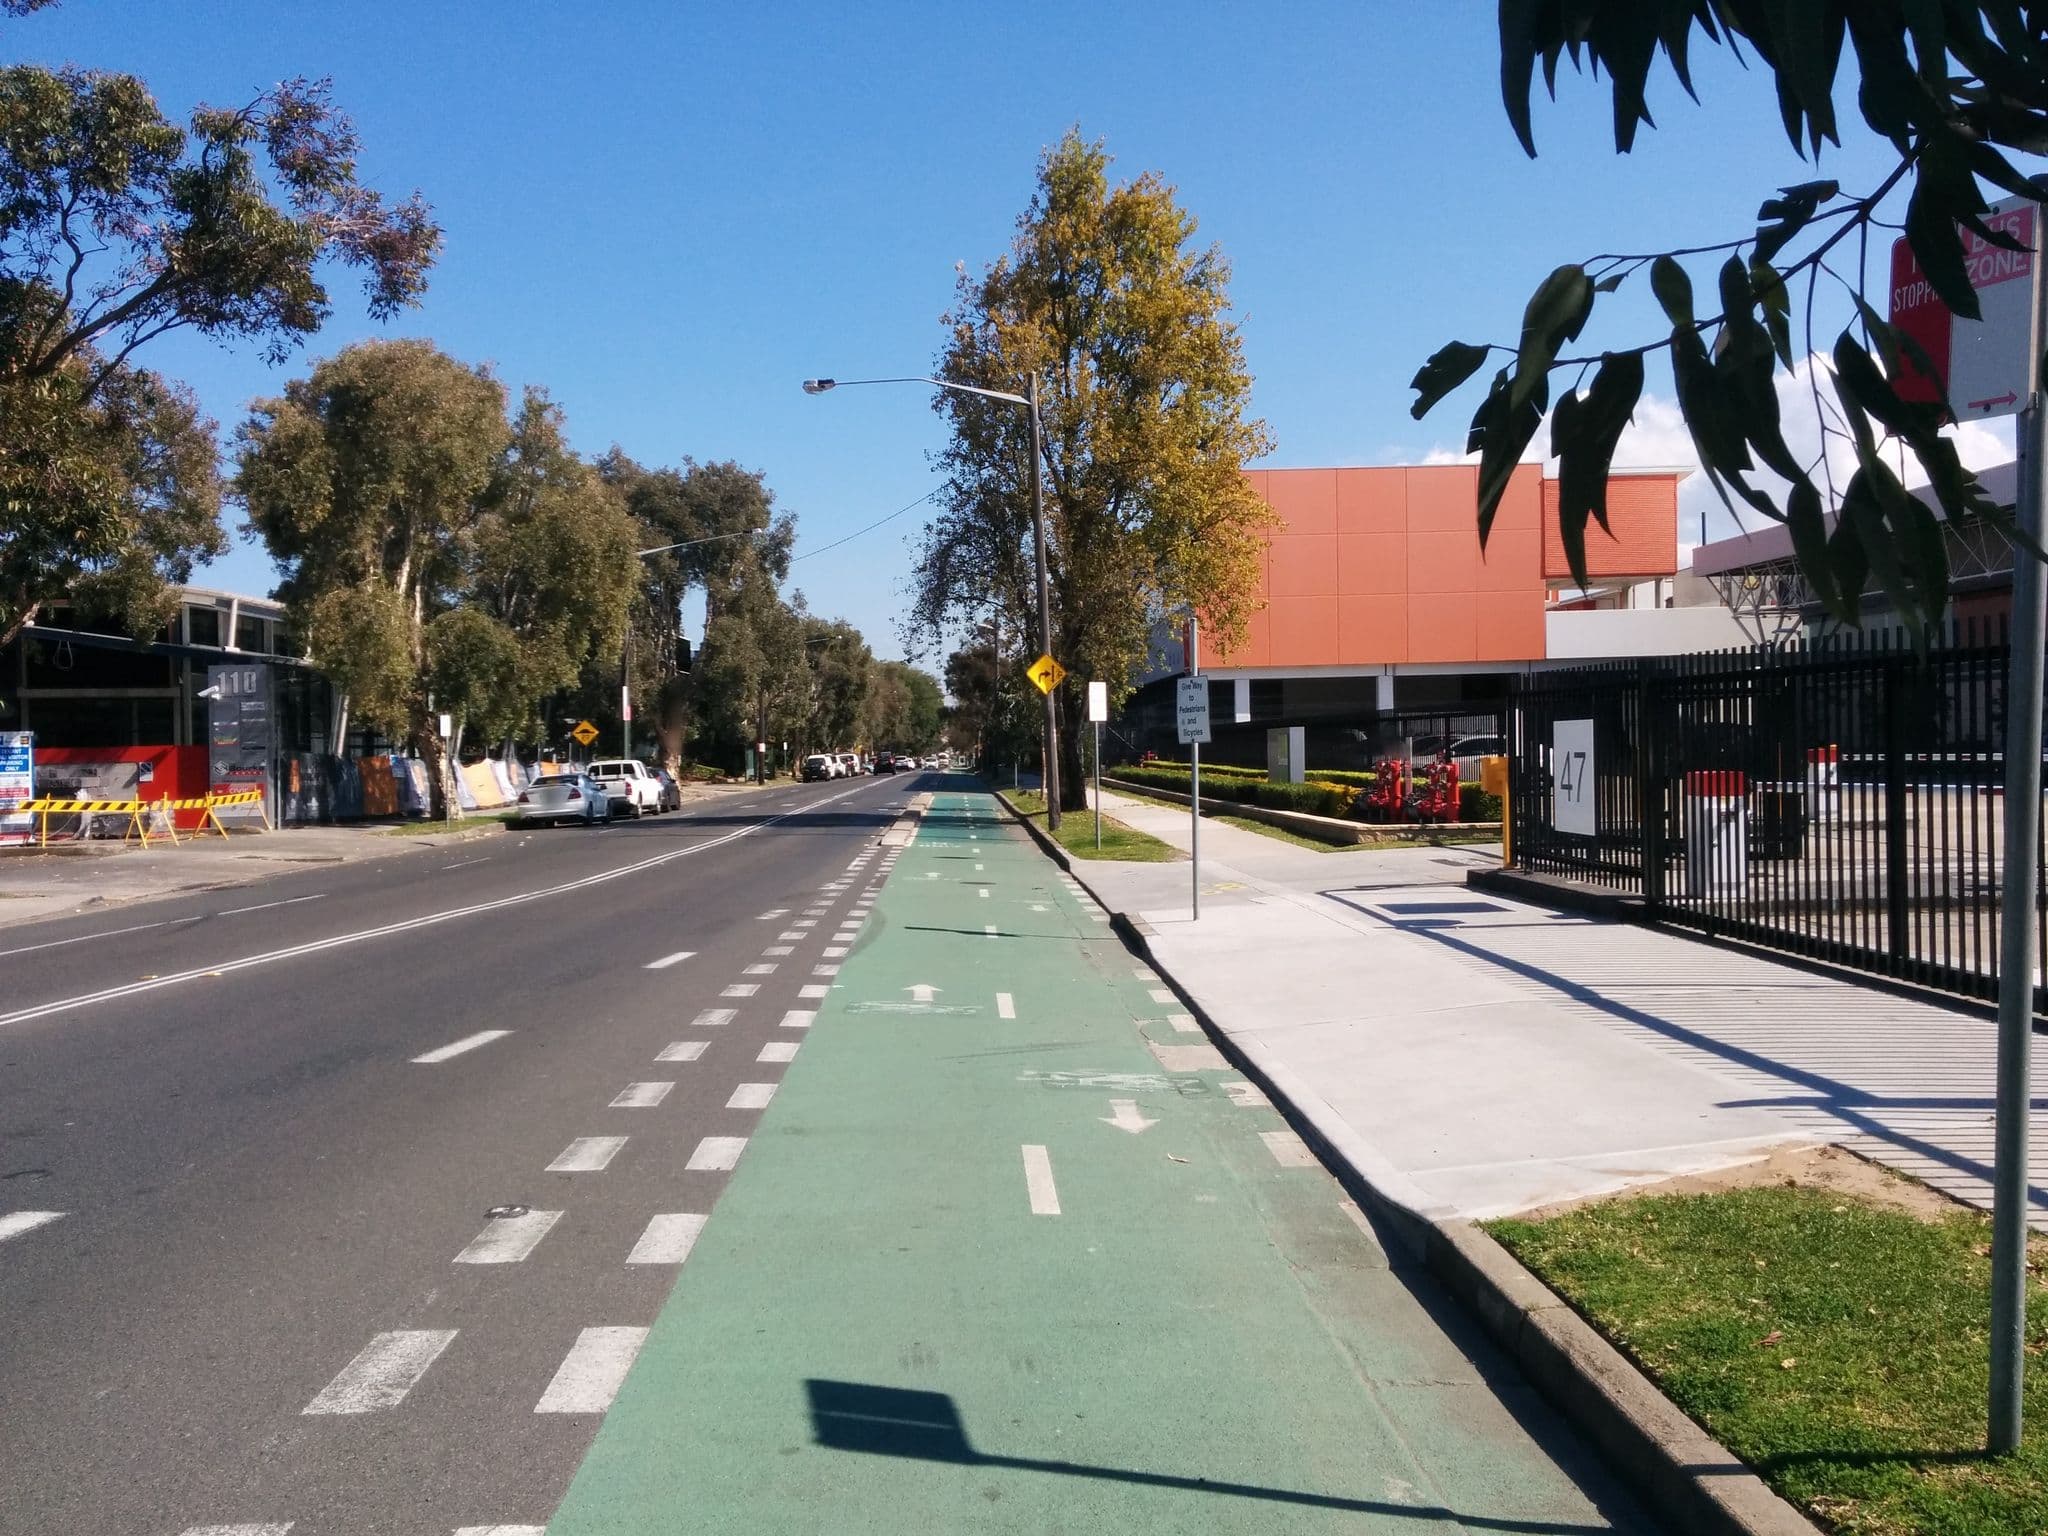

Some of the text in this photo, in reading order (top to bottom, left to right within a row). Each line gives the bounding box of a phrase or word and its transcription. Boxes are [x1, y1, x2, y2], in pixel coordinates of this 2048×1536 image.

[1963, 250, 2027, 284] ZONE
[217, 671, 257, 694] 110
[1181, 682, 1203, 691] Give Way
[1179, 705, 1206, 714] Pedestrians
[1187, 717, 1197, 725] and
[1183, 728, 1203, 738] Bicycles
[1560, 750, 1586, 802] 47
